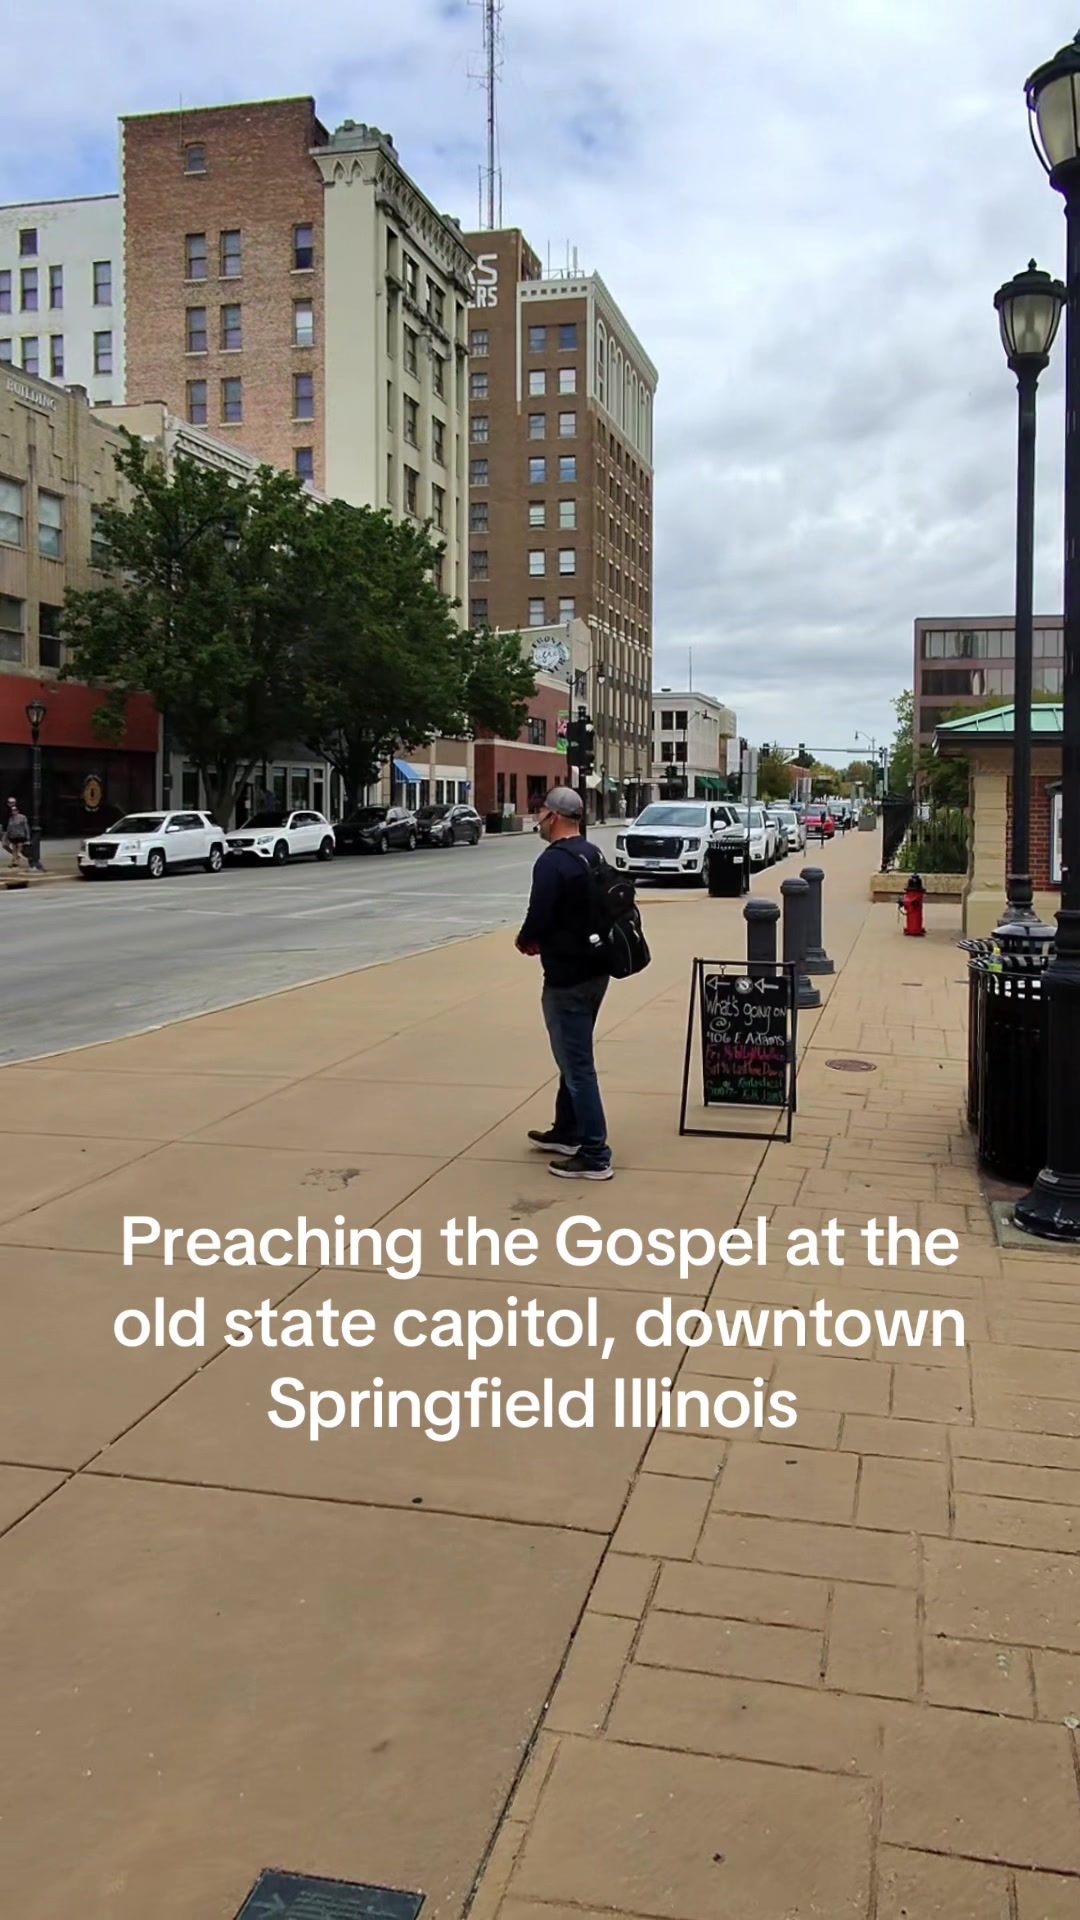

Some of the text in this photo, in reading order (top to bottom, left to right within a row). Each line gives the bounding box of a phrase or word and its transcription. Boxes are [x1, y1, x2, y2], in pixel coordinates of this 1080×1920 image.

[6, 379, 57, 411] BUILDING
[705, 991, 740, 1017] What's
[709, 1017, 731, 1033] @
[745, 1032, 785, 1047] Adams
